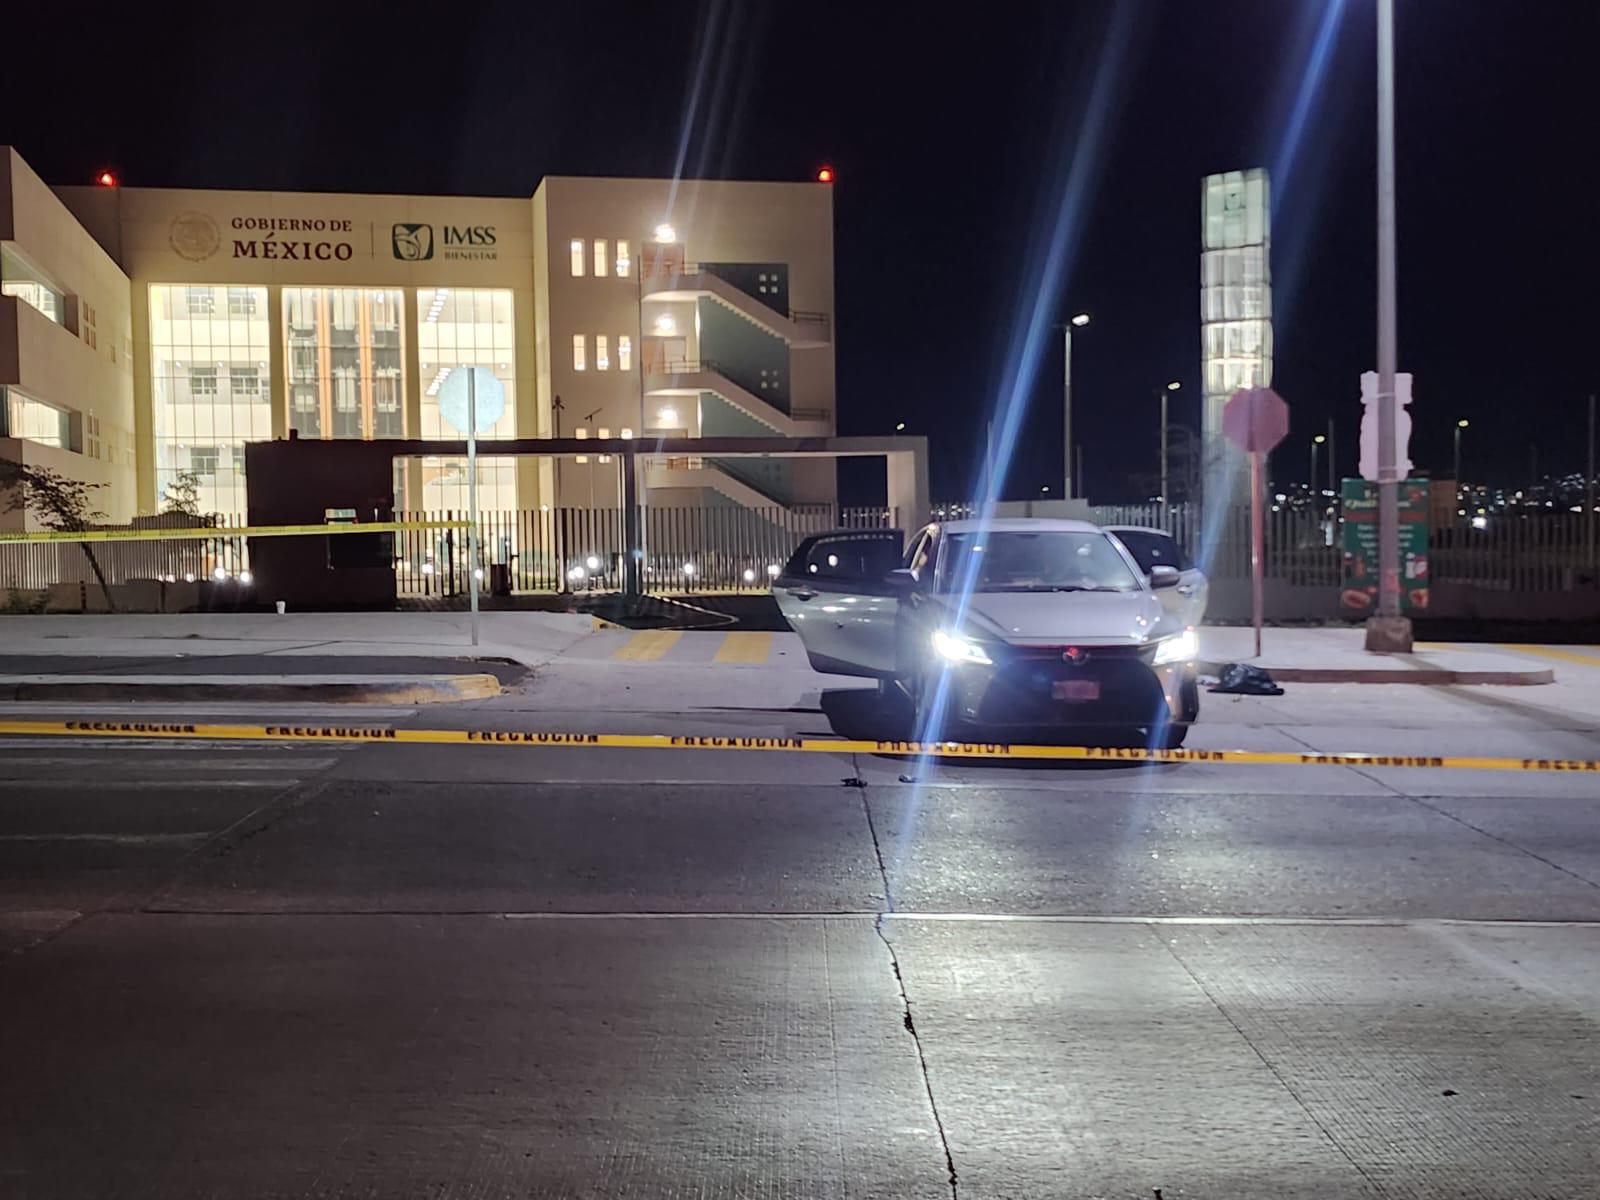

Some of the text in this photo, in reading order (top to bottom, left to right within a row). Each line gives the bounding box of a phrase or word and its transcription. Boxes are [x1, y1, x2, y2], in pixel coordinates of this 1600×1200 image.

[231, 217, 352, 232] GOBIERNO DE
[443, 225, 497, 246] IMSS
[232, 231, 353, 261] MÉXICO
[444, 251, 497, 260] BIENESTAR
